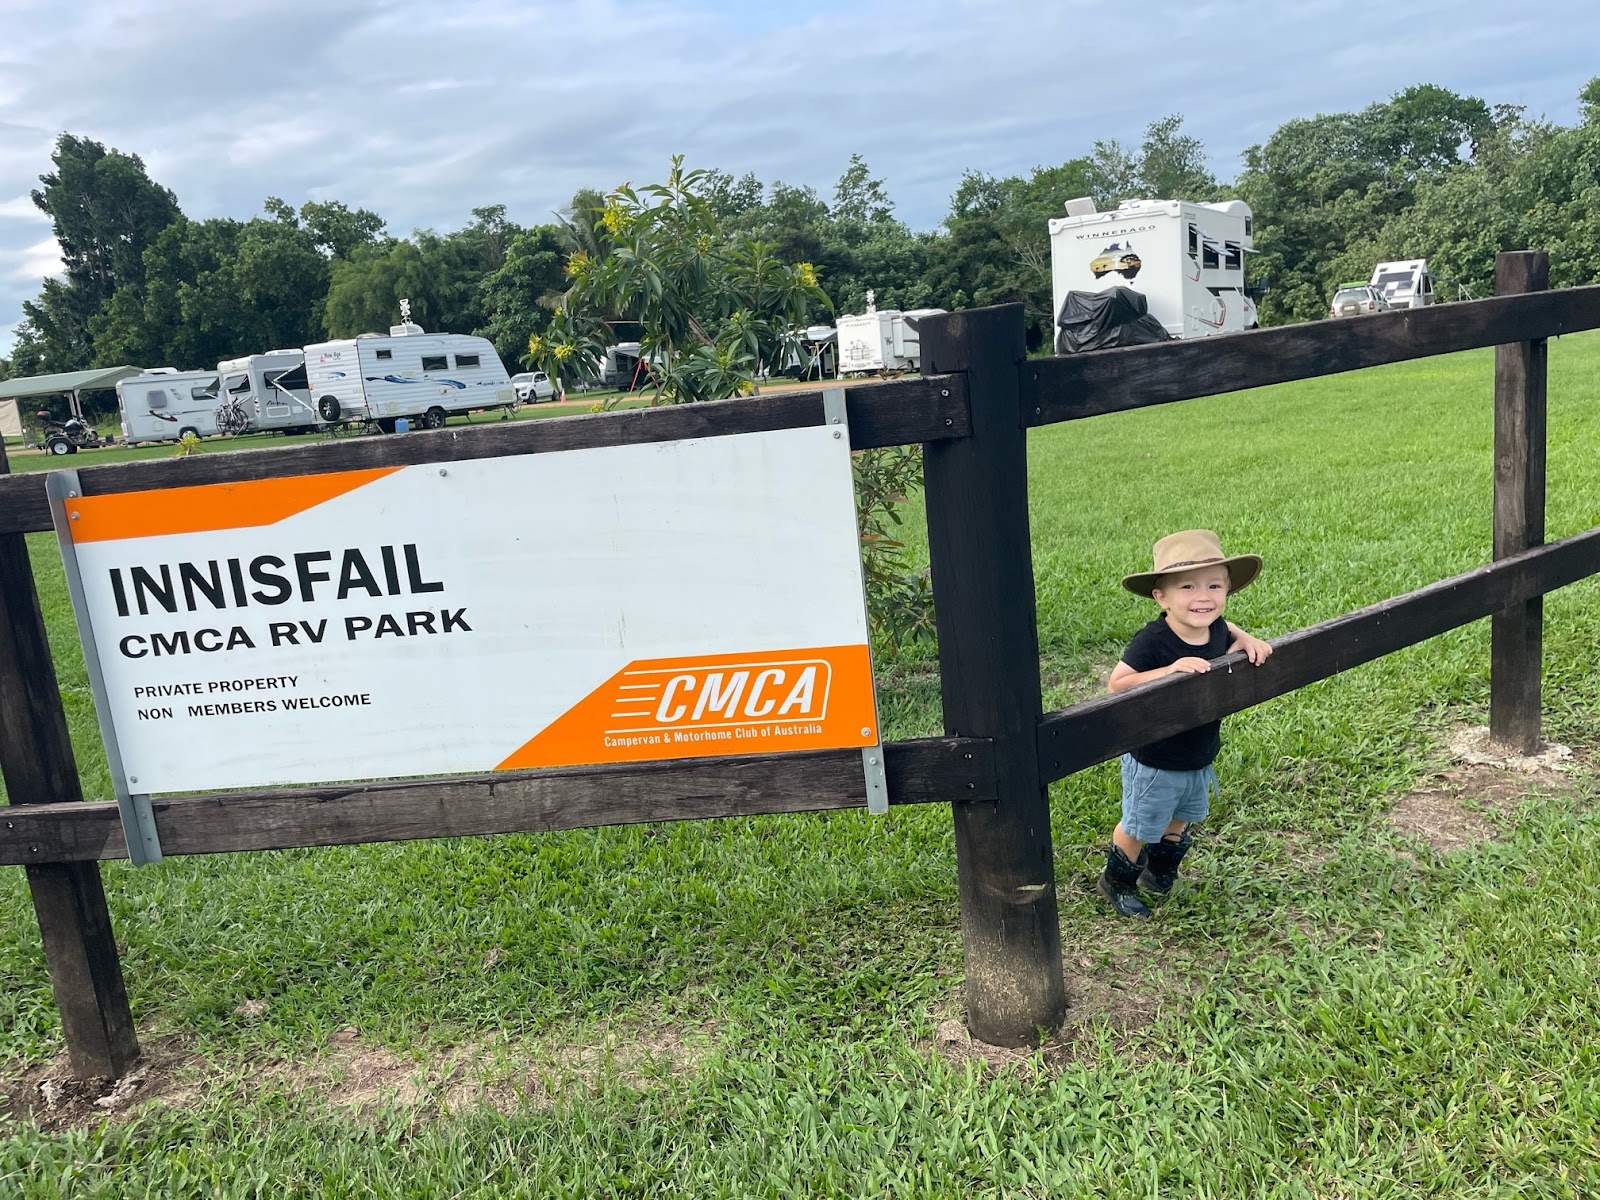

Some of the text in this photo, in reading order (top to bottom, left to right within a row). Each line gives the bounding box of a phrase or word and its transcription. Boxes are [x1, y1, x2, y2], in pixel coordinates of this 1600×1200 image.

[1076, 224, 1156, 240] WINNEBAGO
[109, 543, 444, 617] INNISFAIL
[119, 607, 473, 659] CMCA RV PARK
[134, 675, 299, 698] PRIVATE PROPERTY
[655, 666, 817, 723] CMCA
[137, 693, 372, 721] NON MEMBERS WELCOME
[604, 723, 822, 748] Campervan & Motorhome Club of Australia
